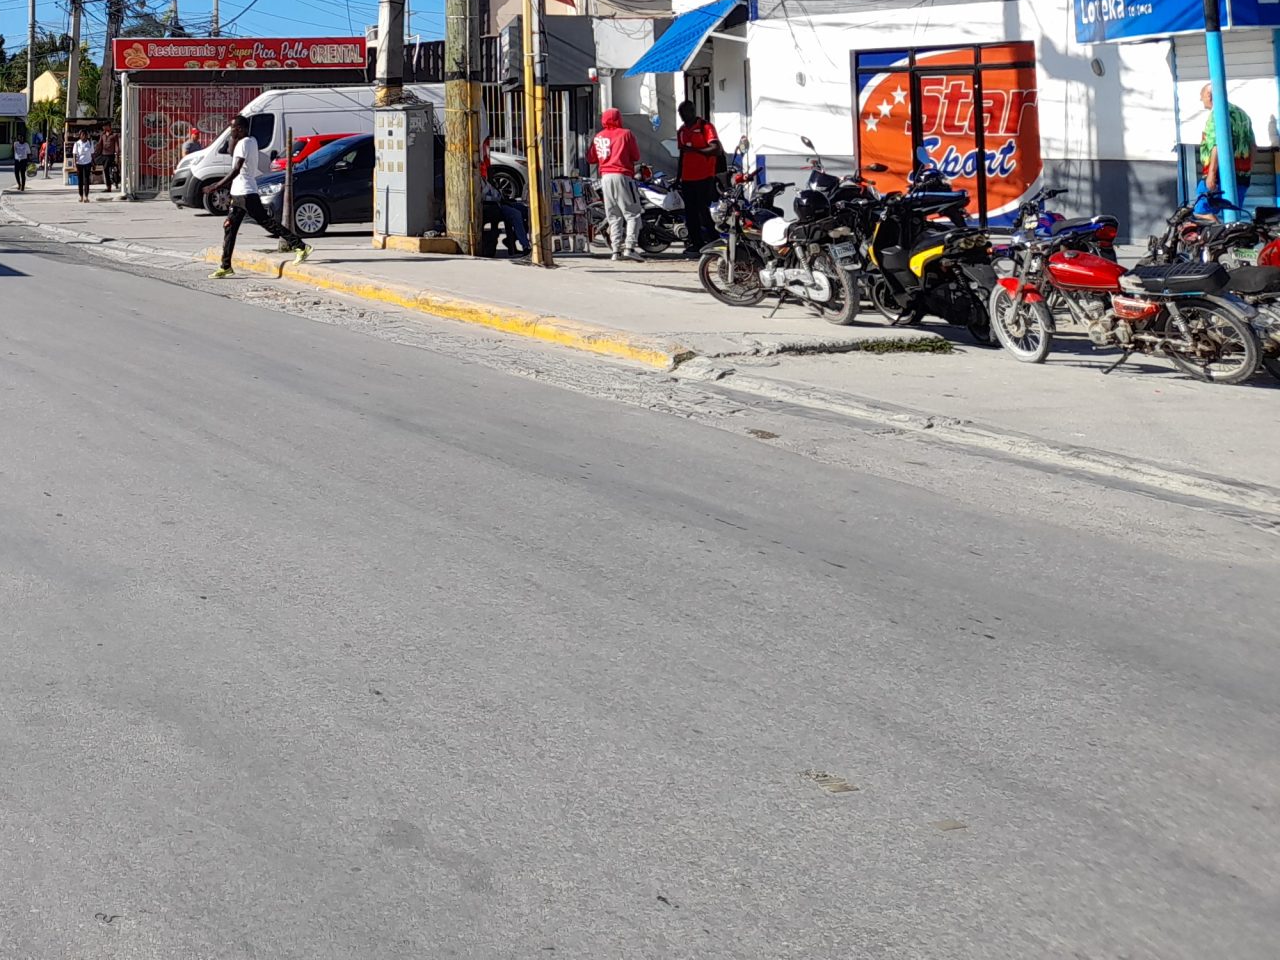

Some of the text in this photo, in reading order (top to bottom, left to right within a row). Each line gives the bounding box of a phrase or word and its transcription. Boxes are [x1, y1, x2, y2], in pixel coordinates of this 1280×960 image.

[148, 41, 364, 64] Restaurante y Super Pica Pollo ORIENTAL
[905, 76, 1038, 136] Star
[907, 136, 1017, 184] Sport
